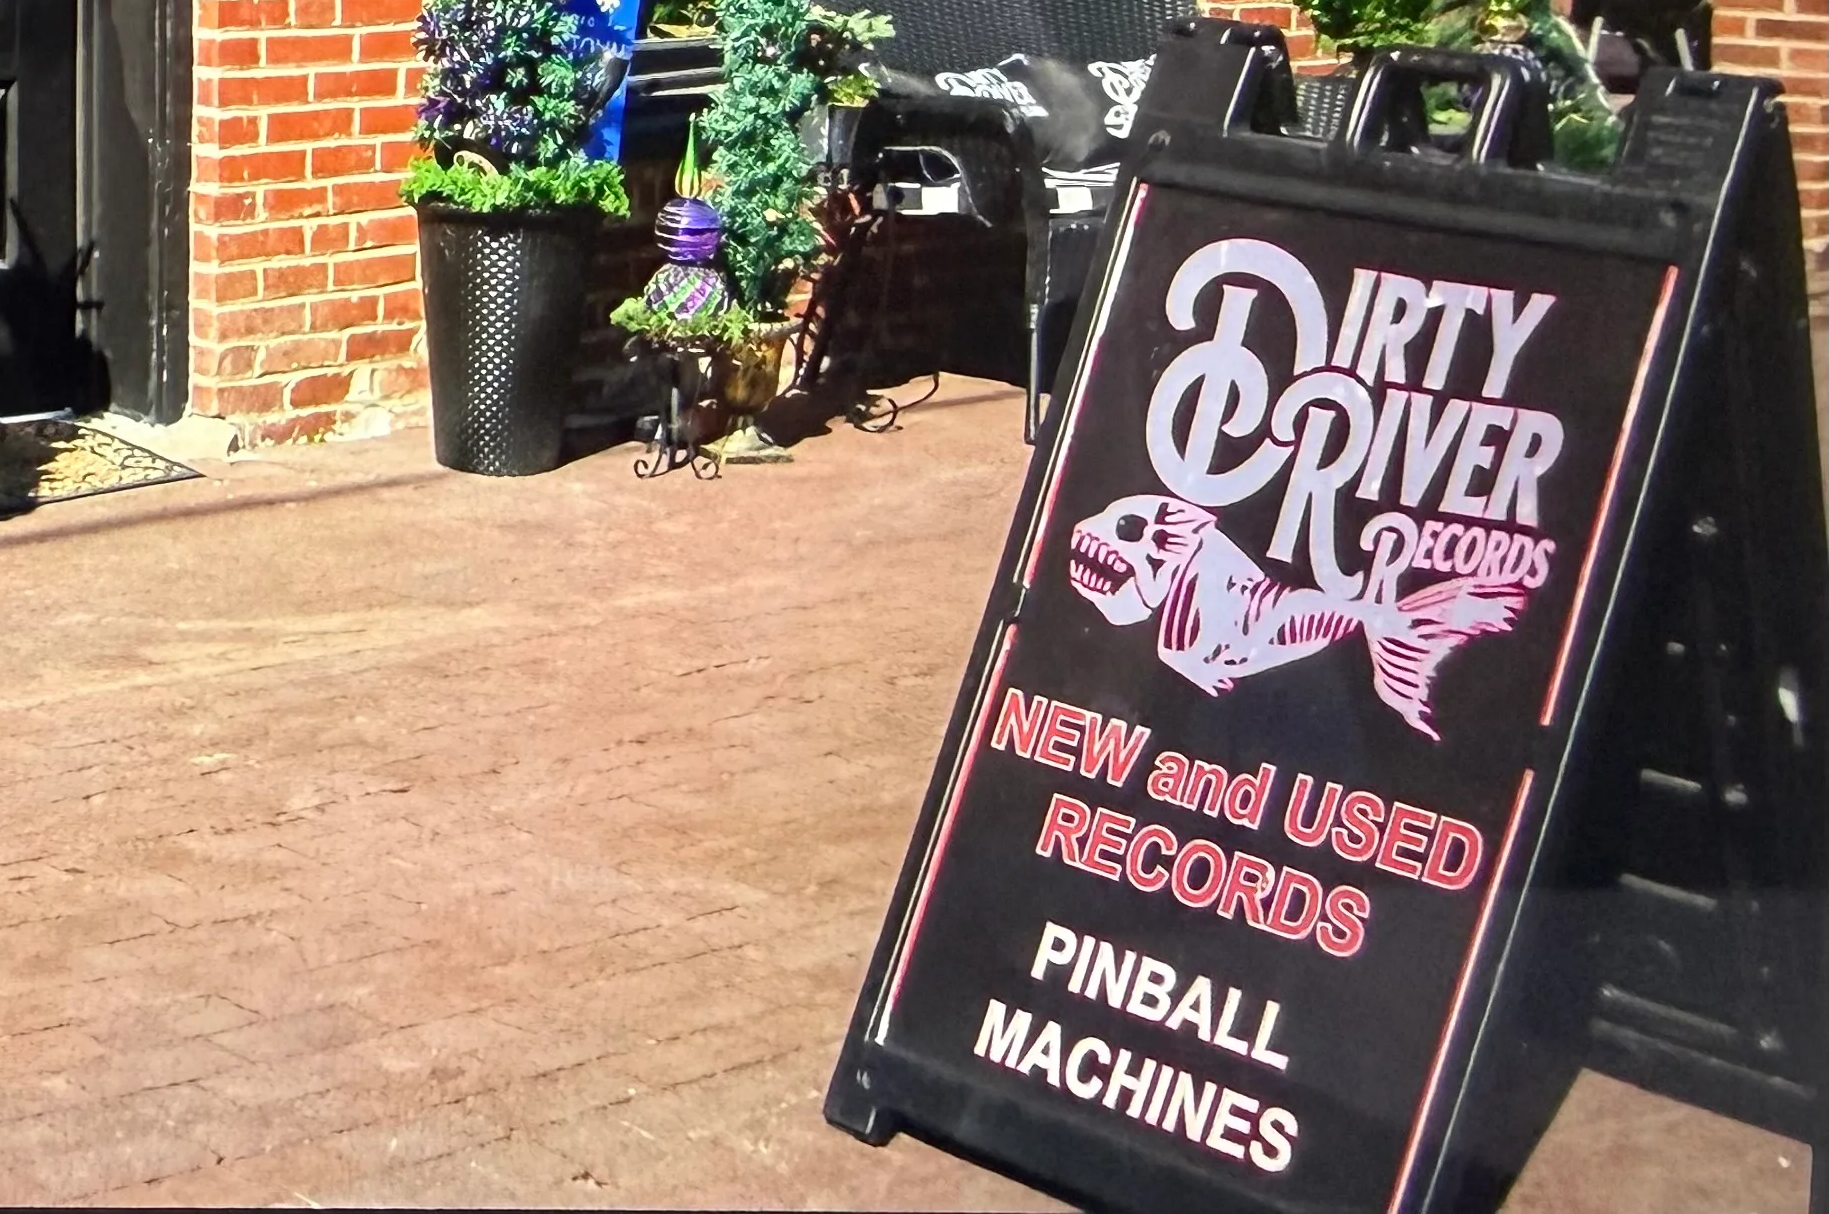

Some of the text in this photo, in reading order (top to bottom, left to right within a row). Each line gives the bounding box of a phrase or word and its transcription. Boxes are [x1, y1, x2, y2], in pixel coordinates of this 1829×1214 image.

[1146, 238, 1558, 507] DIRTY
[1271, 371, 1565, 602] RIVER
[1361, 511, 1557, 604] RECORDS
[990, 688, 1485, 891] NEW and USED
[1036, 793, 1371, 958] RECORDS
[1030, 920, 1291, 1072] PINBALL
[973, 998, 1300, 1174] MACHINES
